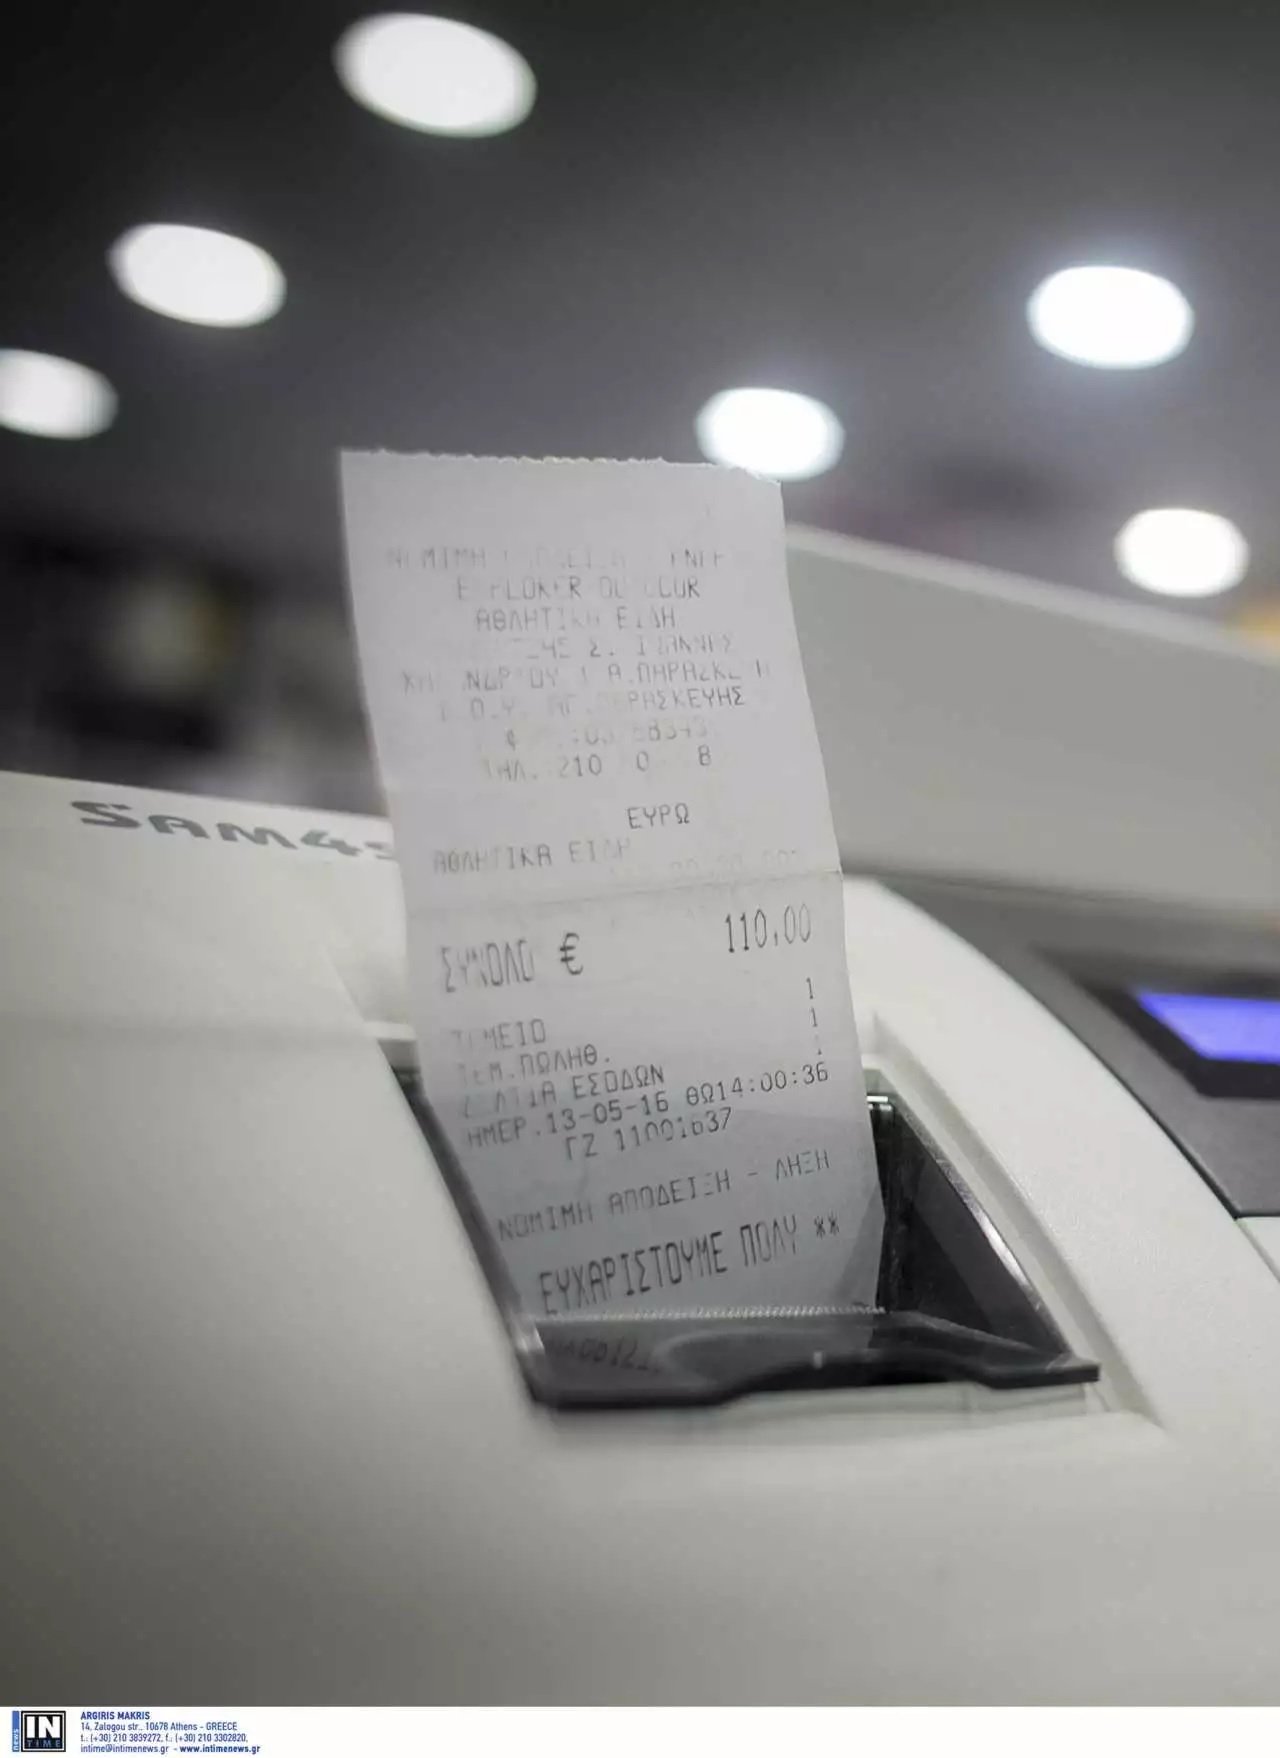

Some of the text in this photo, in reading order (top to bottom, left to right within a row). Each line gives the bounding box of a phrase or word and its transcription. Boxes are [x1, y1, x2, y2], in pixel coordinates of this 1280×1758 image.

[559, 752, 602, 778] 210
[627, 802, 691, 830] ΕΥΡΩ
[559, 932, 584, 976] €
[572, 1063, 665, 1099] ΕΣΟΔΩΝ
[499, 1200, 594, 1241] ΝΟΜΙΜΗ
[608, 1169, 731, 1216] ΑΠΟΔΕΙΞΗ
[774, 1149, 830, 1181] ΛΗΞΗ
[539, 1230, 728, 1315] ΕΥΧΑΡΙΣΤΟΥΜΕ
[740, 1213, 798, 1268] ΠΟΛΥ
